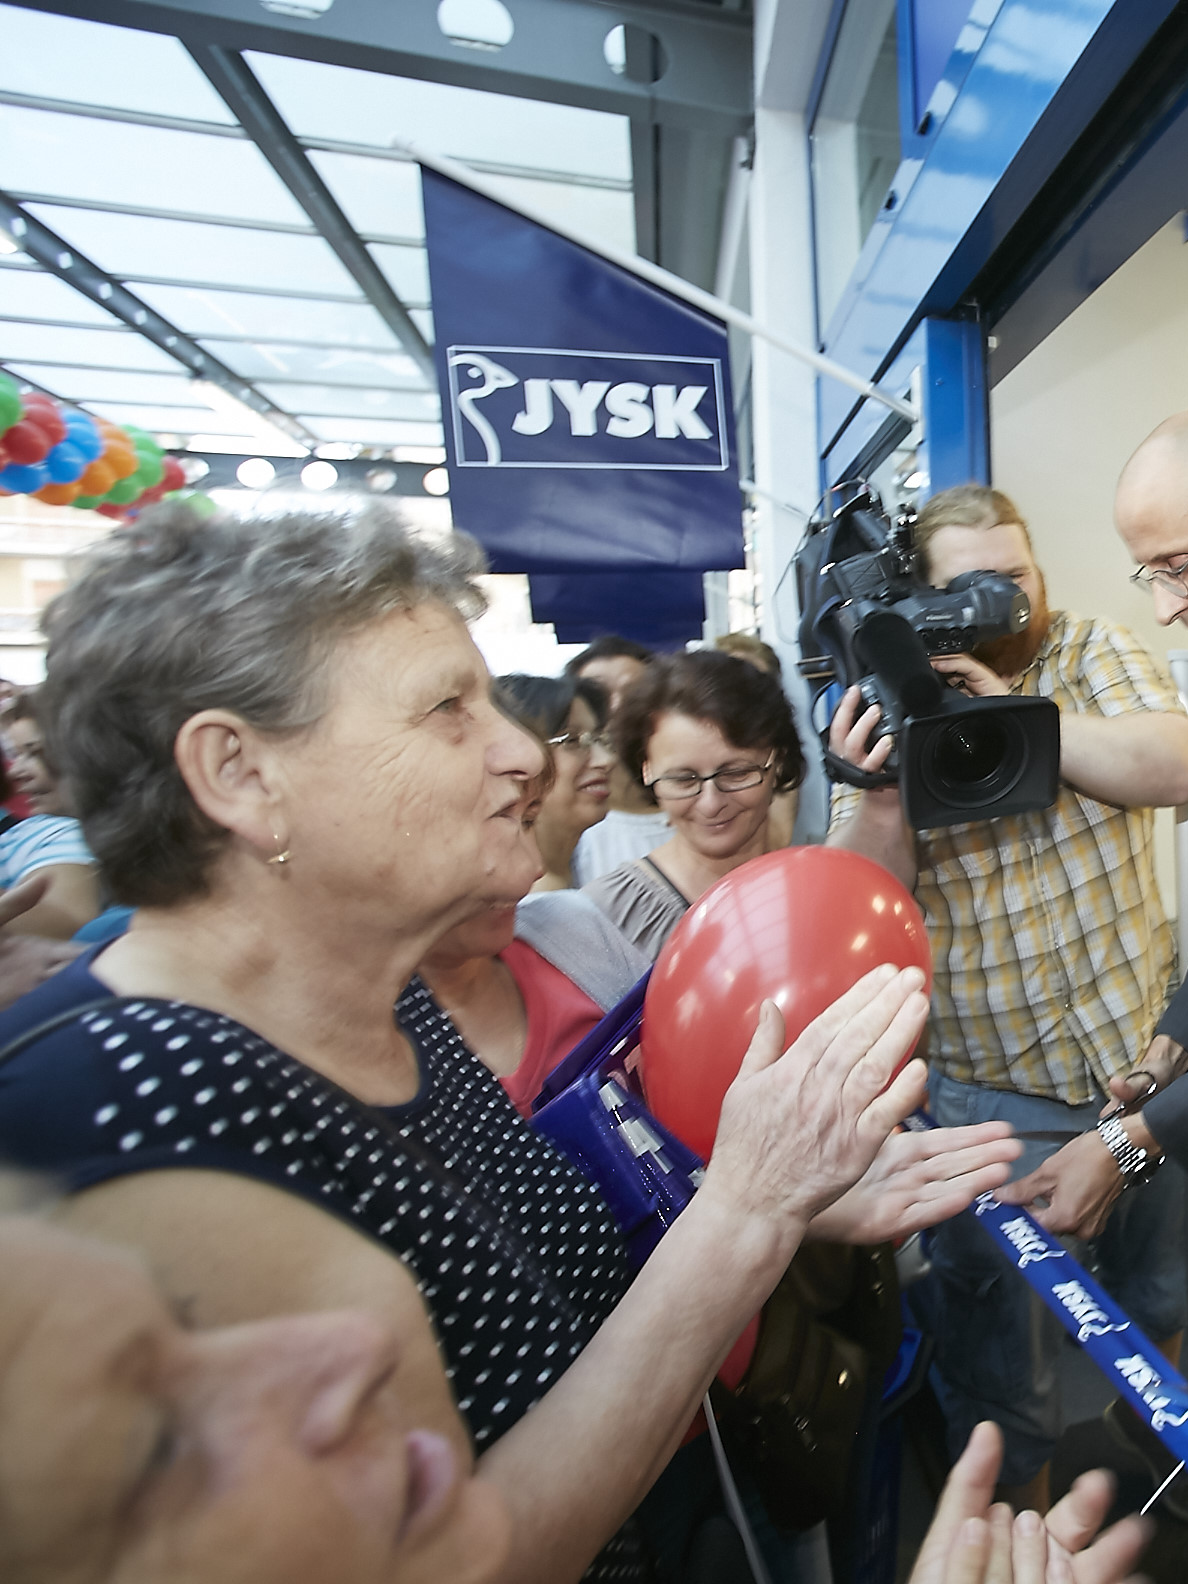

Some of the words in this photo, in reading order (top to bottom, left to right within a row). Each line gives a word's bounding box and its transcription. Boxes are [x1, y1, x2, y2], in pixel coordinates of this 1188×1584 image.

[511, 378, 714, 440] JYSK
[1000, 1216, 1049, 1254] JYSK
[1051, 1280, 1110, 1325] JYSK
